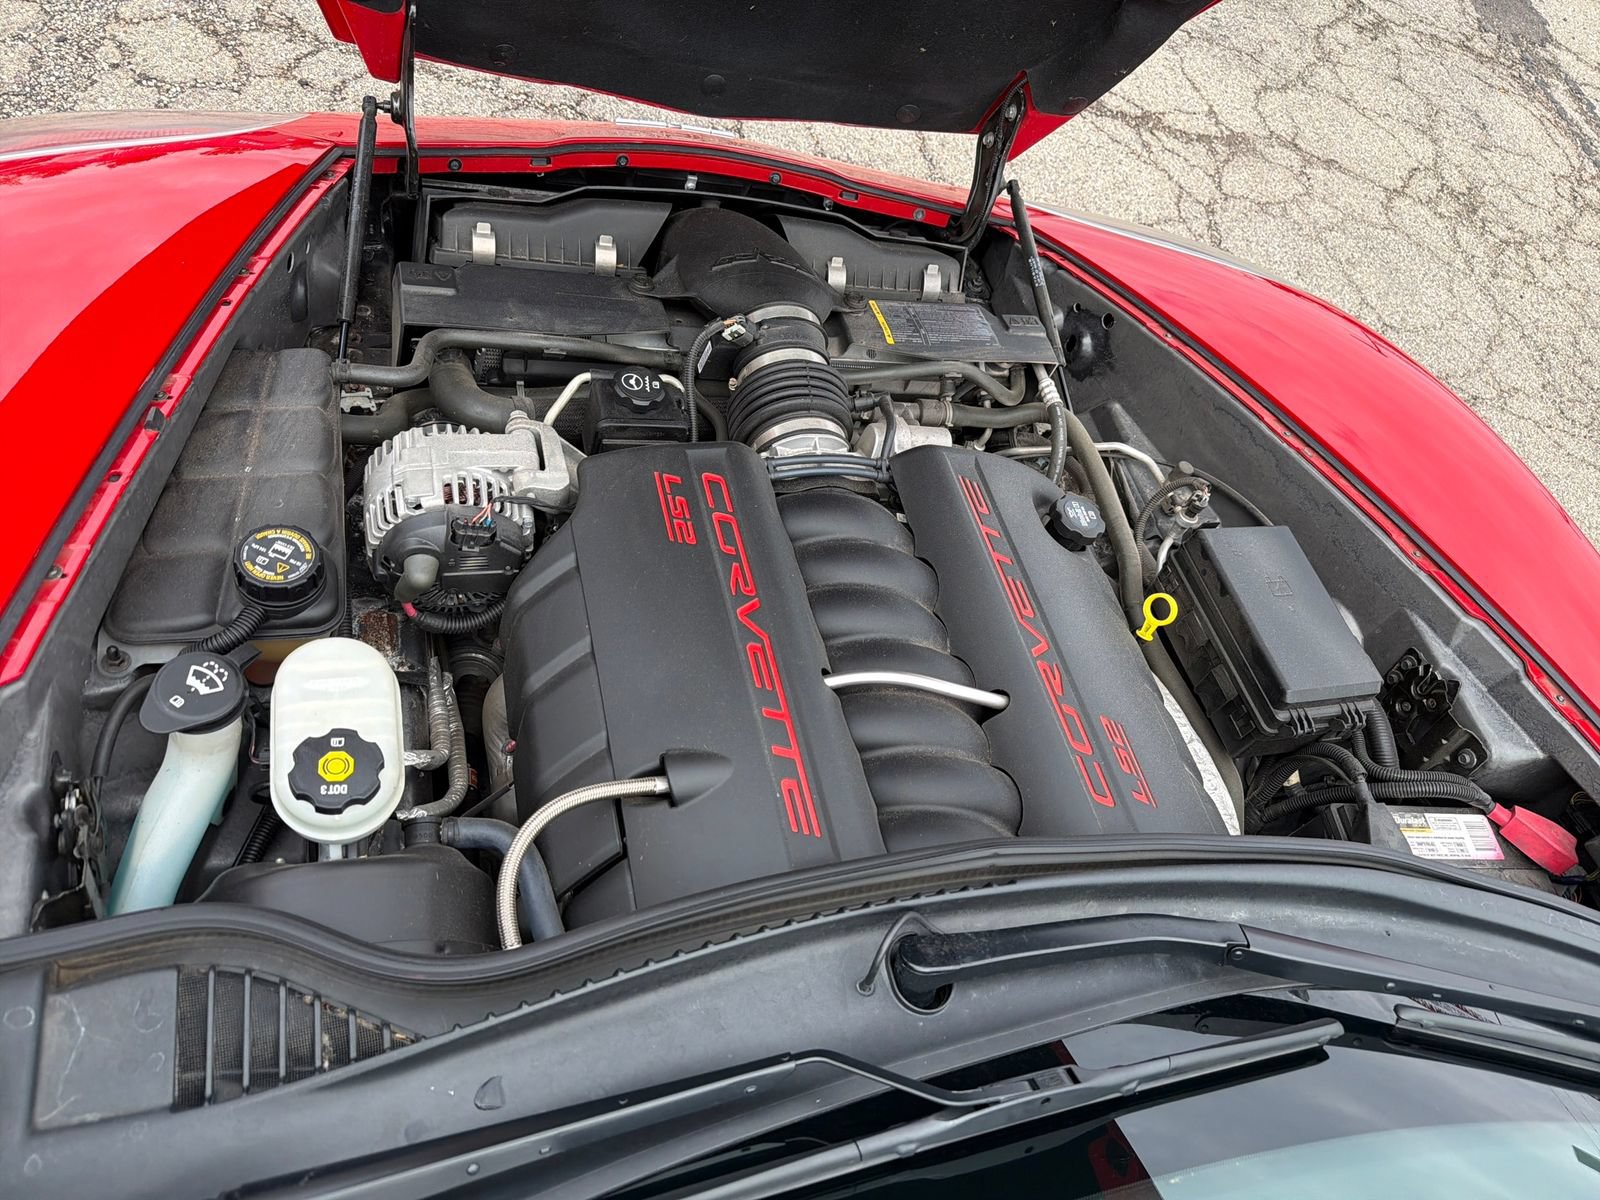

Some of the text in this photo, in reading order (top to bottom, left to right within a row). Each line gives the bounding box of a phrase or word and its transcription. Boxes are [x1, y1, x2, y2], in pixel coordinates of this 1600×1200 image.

[663, 472, 697, 545] LS2
[252, 568, 266, 579] OPEN
[701, 472, 822, 838] CORVETTE
[958, 475, 1116, 808] CORVETTE
[320, 784, 348, 795] DOT 3
[1099, 714, 1151, 806] LS2
